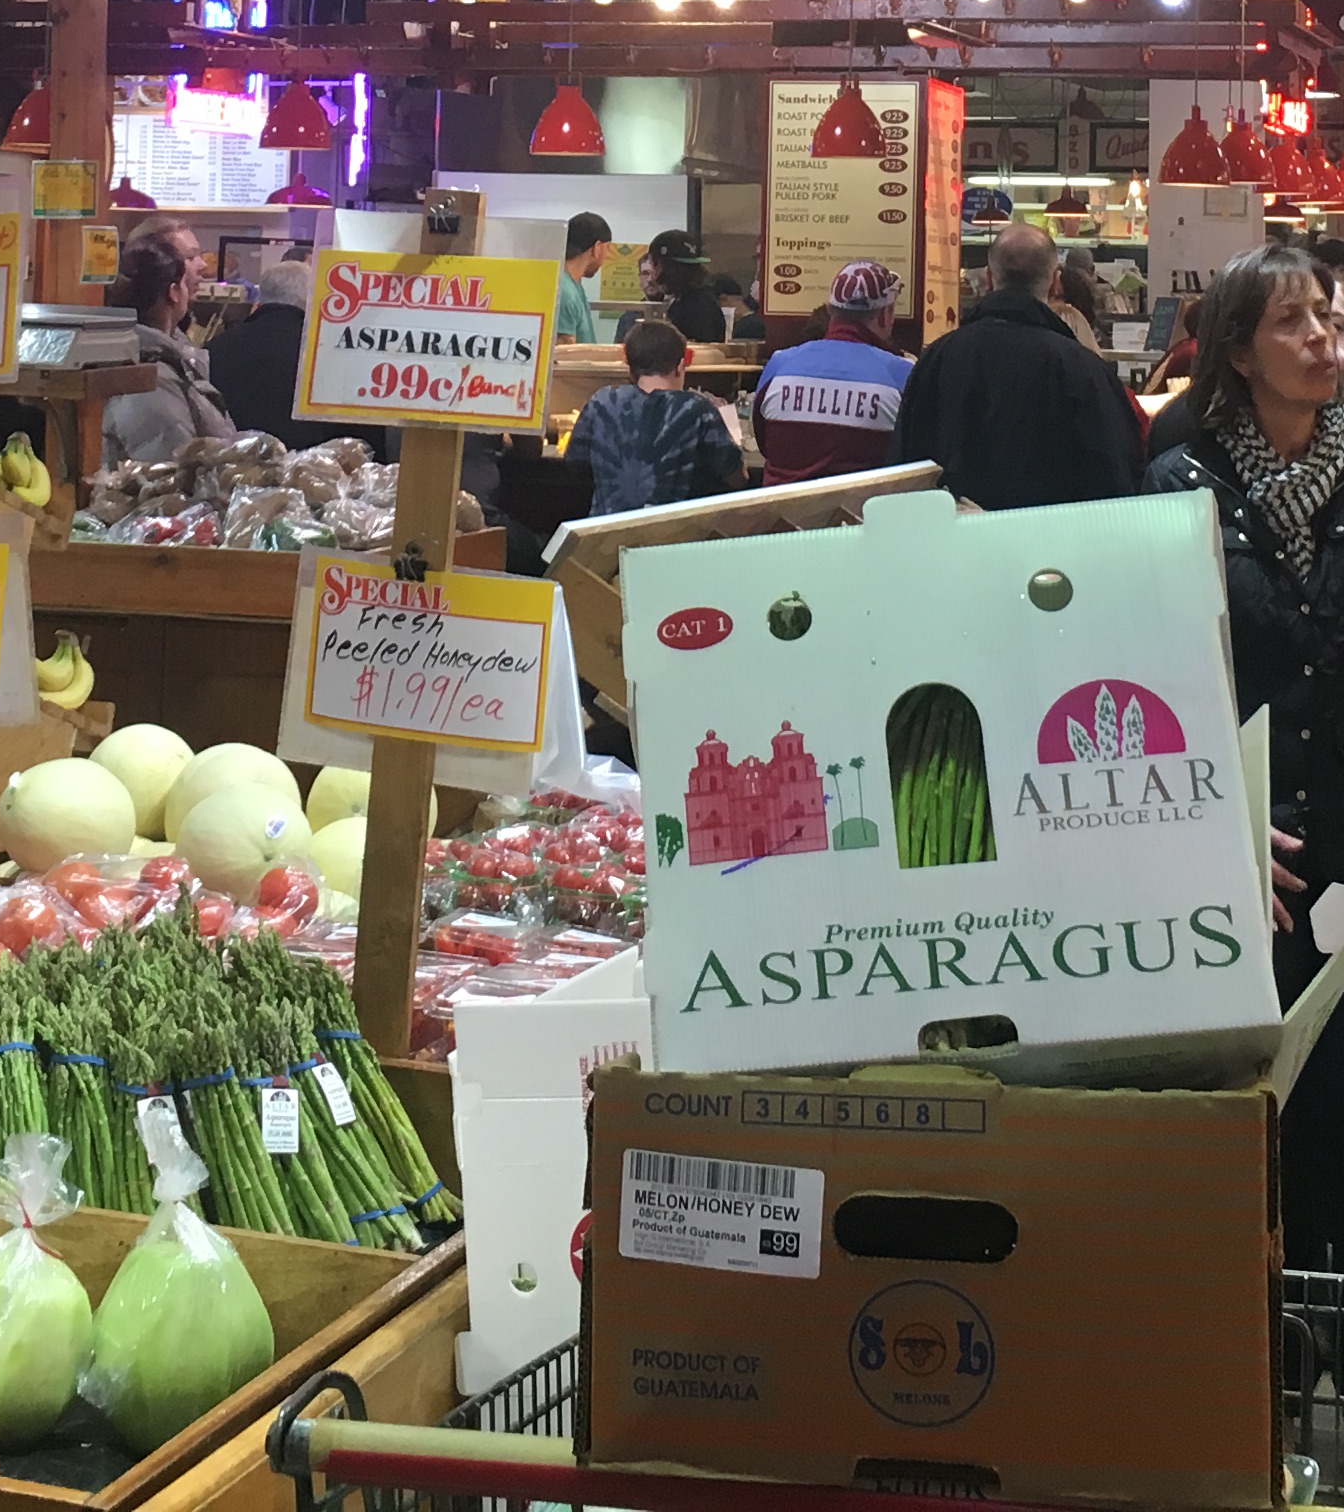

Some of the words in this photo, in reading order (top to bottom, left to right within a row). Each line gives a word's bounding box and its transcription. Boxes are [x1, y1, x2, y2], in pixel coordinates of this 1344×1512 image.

[777, 112, 807, 121] ROAST
[777, 128, 807, 137] ROAST
[776, 160, 828, 170] MEATBALLS
[775, 182, 810, 191] ITALIAN
[814, 182, 839, 192] STYLE
[775, 192, 809, 201] PULLED
[812, 192, 837, 201] PORK
[775, 214, 809, 224] BRISKET
[812, 214, 826, 223] OF
[829, 215, 850, 224] BEEF
[775, 237, 832, 250] Toppings
[320, 261, 492, 323] SPECIAL
[336, 326, 533, 363] ASPARAGUS
[781, 385, 880, 420] PHILLIES
[320, 564, 451, 615] SPECIAL
[357, 606, 444, 637] Fresh
[662, 619, 706, 639] CAT
[322, 630, 419, 666] Peeled
[423, 641, 538, 683] Honeydew
[1013, 757, 1225, 819] ALTAR
[1038, 809, 1150, 833] PRODUCE
[1156, 804, 1205, 825] LLC
[823, 914, 946, 946] Premium
[953, 907, 1055, 941] Quality
[680, 903, 1242, 1013] ASPARAGUS
[644, 1092, 733, 1119] COUNT
[756, 1097, 770, 1116] 3
[794, 1099, 810, 1119] 4
[836, 1100, 851, 1122] 5
[875, 1102, 890, 1124] 6
[915, 1104, 930, 1125] 8
[760, 1204, 801, 1223] DEW
[632, 1219, 673, 1234] Product
[676, 1226, 687, 1236] of
[689, 1227, 746, 1244] Guatemala
[772, 1232, 798, 1255] 99
[632, 1348, 726, 1373] PRODUCT
[733, 1355, 761, 1373] OF
[632, 1376, 760, 1401] GUATEMALA
